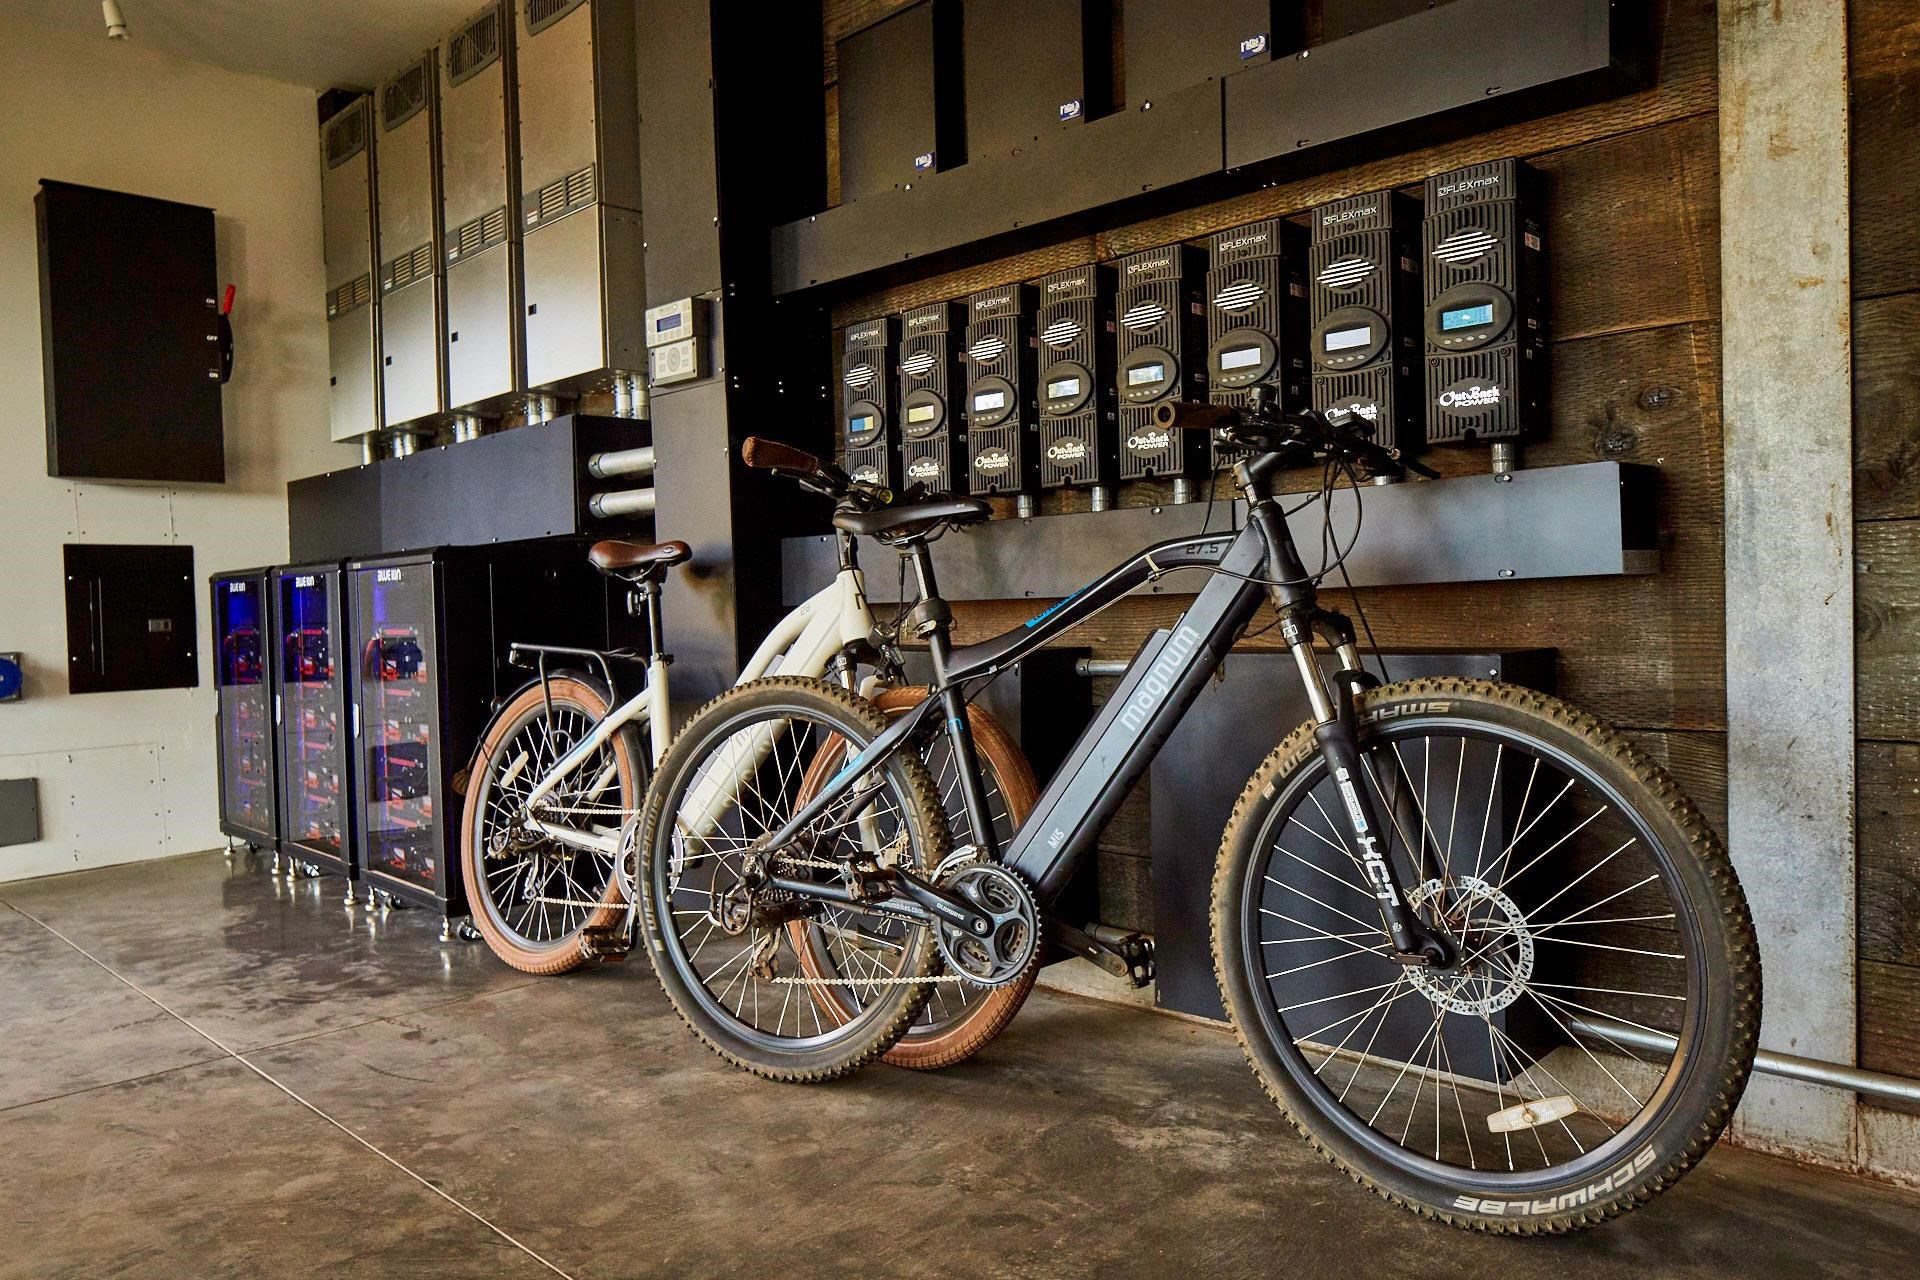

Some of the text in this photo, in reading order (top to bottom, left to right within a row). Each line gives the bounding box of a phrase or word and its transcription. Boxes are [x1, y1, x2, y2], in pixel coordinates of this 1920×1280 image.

[1446, 175, 1500, 195] FLEXmax
[1329, 206, 1377, 223] FLEXmax
[1226, 234, 1267, 250] FLEXmax
[1133, 258, 1171, 273] FLEXmax
[1053, 278, 1087, 291] FLEXmax
[980, 296, 1011, 309] FLEXmax
[1455, 396, 1500, 407] POWER
[1137, 441, 1169, 450] POWER
[1057, 452, 1085, 460] POWER
[984, 461, 1009, 469] POWER
[1186, 542, 1219, 554] 27.5
[1120, 625, 1200, 732] magnum
[1362, 702, 1451, 721] SMAR
[641, 792, 664, 931] SMART SAM
[1356, 836, 1400, 907] XCT
[1453, 1143, 1657, 1216] SCHWALBE
